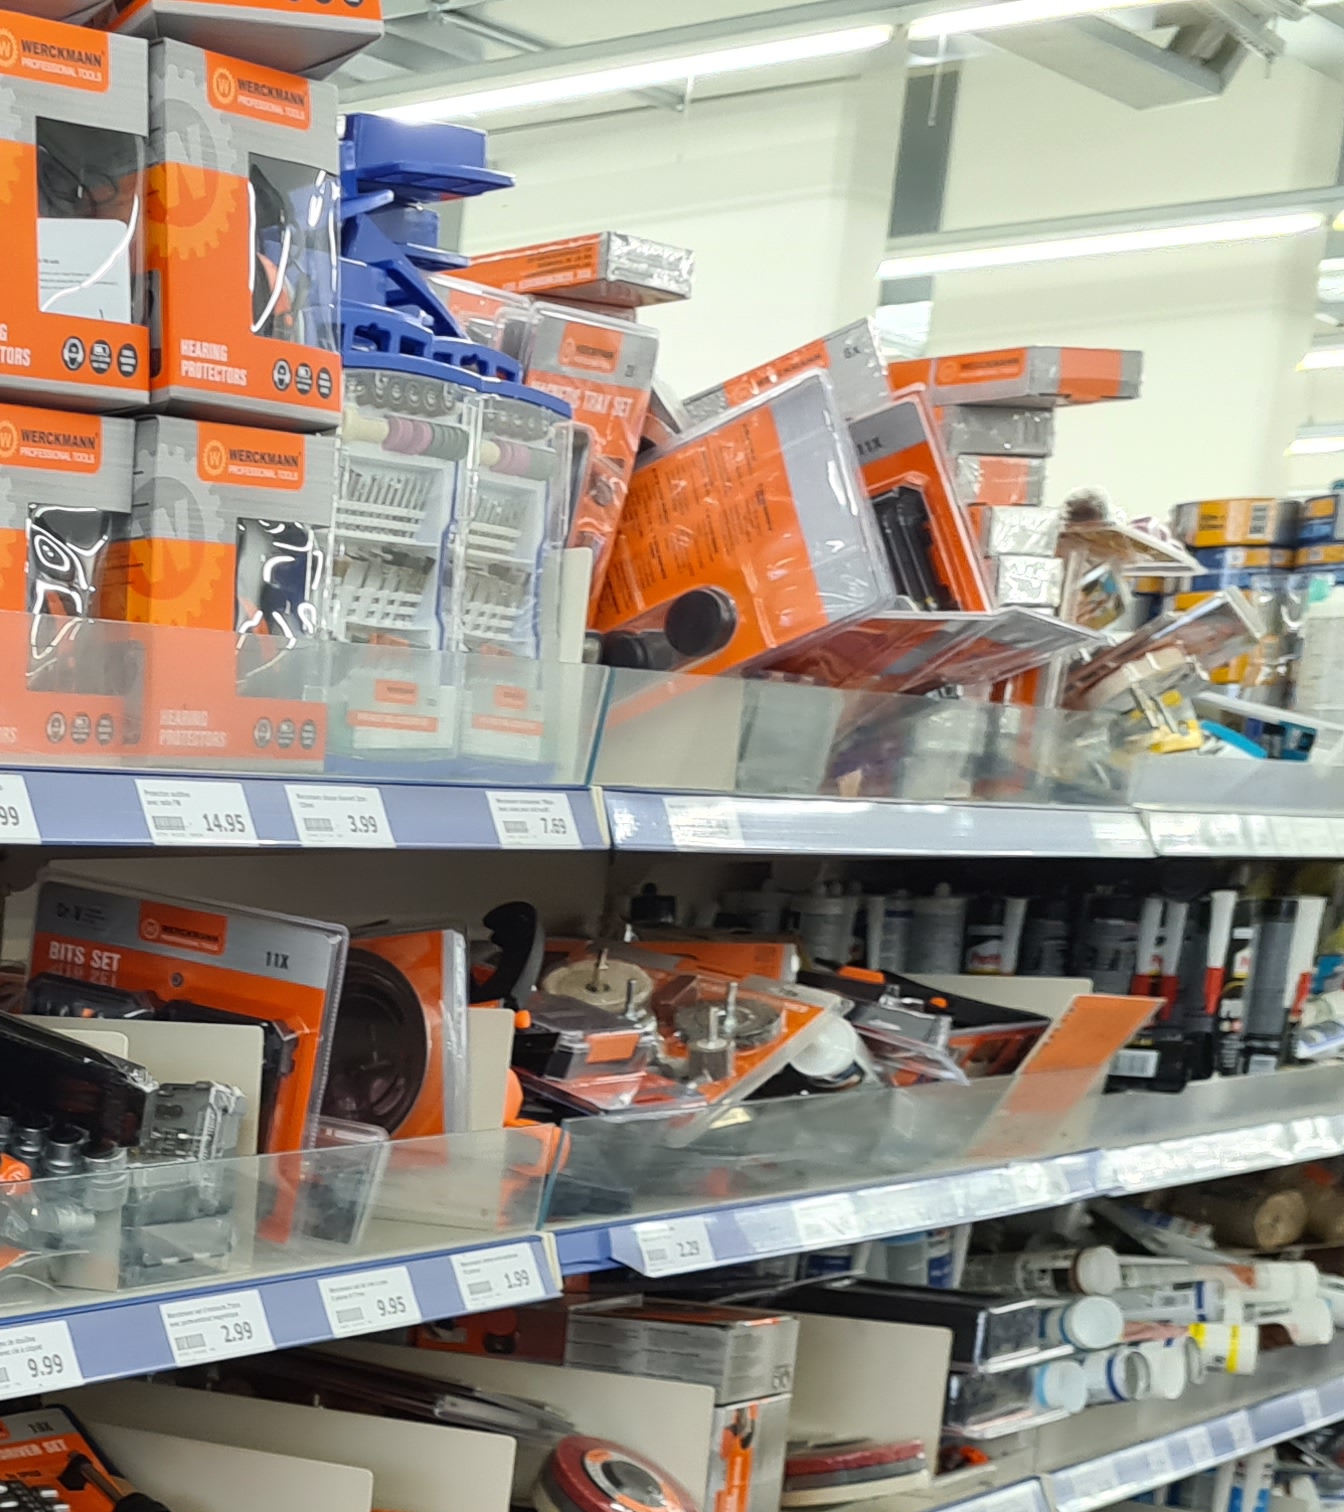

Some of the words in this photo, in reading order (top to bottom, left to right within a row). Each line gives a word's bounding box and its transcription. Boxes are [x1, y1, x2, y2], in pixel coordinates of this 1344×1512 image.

[21, 39, 103, 68] WERCKMANN
[21, 57, 78, 80] PROFESSIONAL
[79, 67, 102, 83] TOOLS
[237, 77, 306, 106] WERCKMANN
[179, 338, 228, 363] HEARING
[180, 359, 248, 387] PROTECTORS
[20, 429, 98, 450] WERCKMANN
[20, 446, 70, 463] PROFESSIONAL
[72, 449, 95, 464] TOOLS
[227, 448, 301, 469] WERCKMANN
[227, 463, 277, 479] PROFESSIONAL
[277, 467, 299, 481] TOOLS
[159, 708, 209, 727] HEARING
[159, 730, 228, 748] PROTECTORS
[202, 812, 246, 834] 14.95
[348, 814, 379, 834] 3.99
[49, 940, 85, 967] BITS
[91, 949, 122, 973] SET
[376, 1296, 406, 1317] 9.95
[220, 1321, 254, 1344] 2.99
[27, 1354, 64, 1378] 9.99
[51, 1439, 69, 1452] SET
